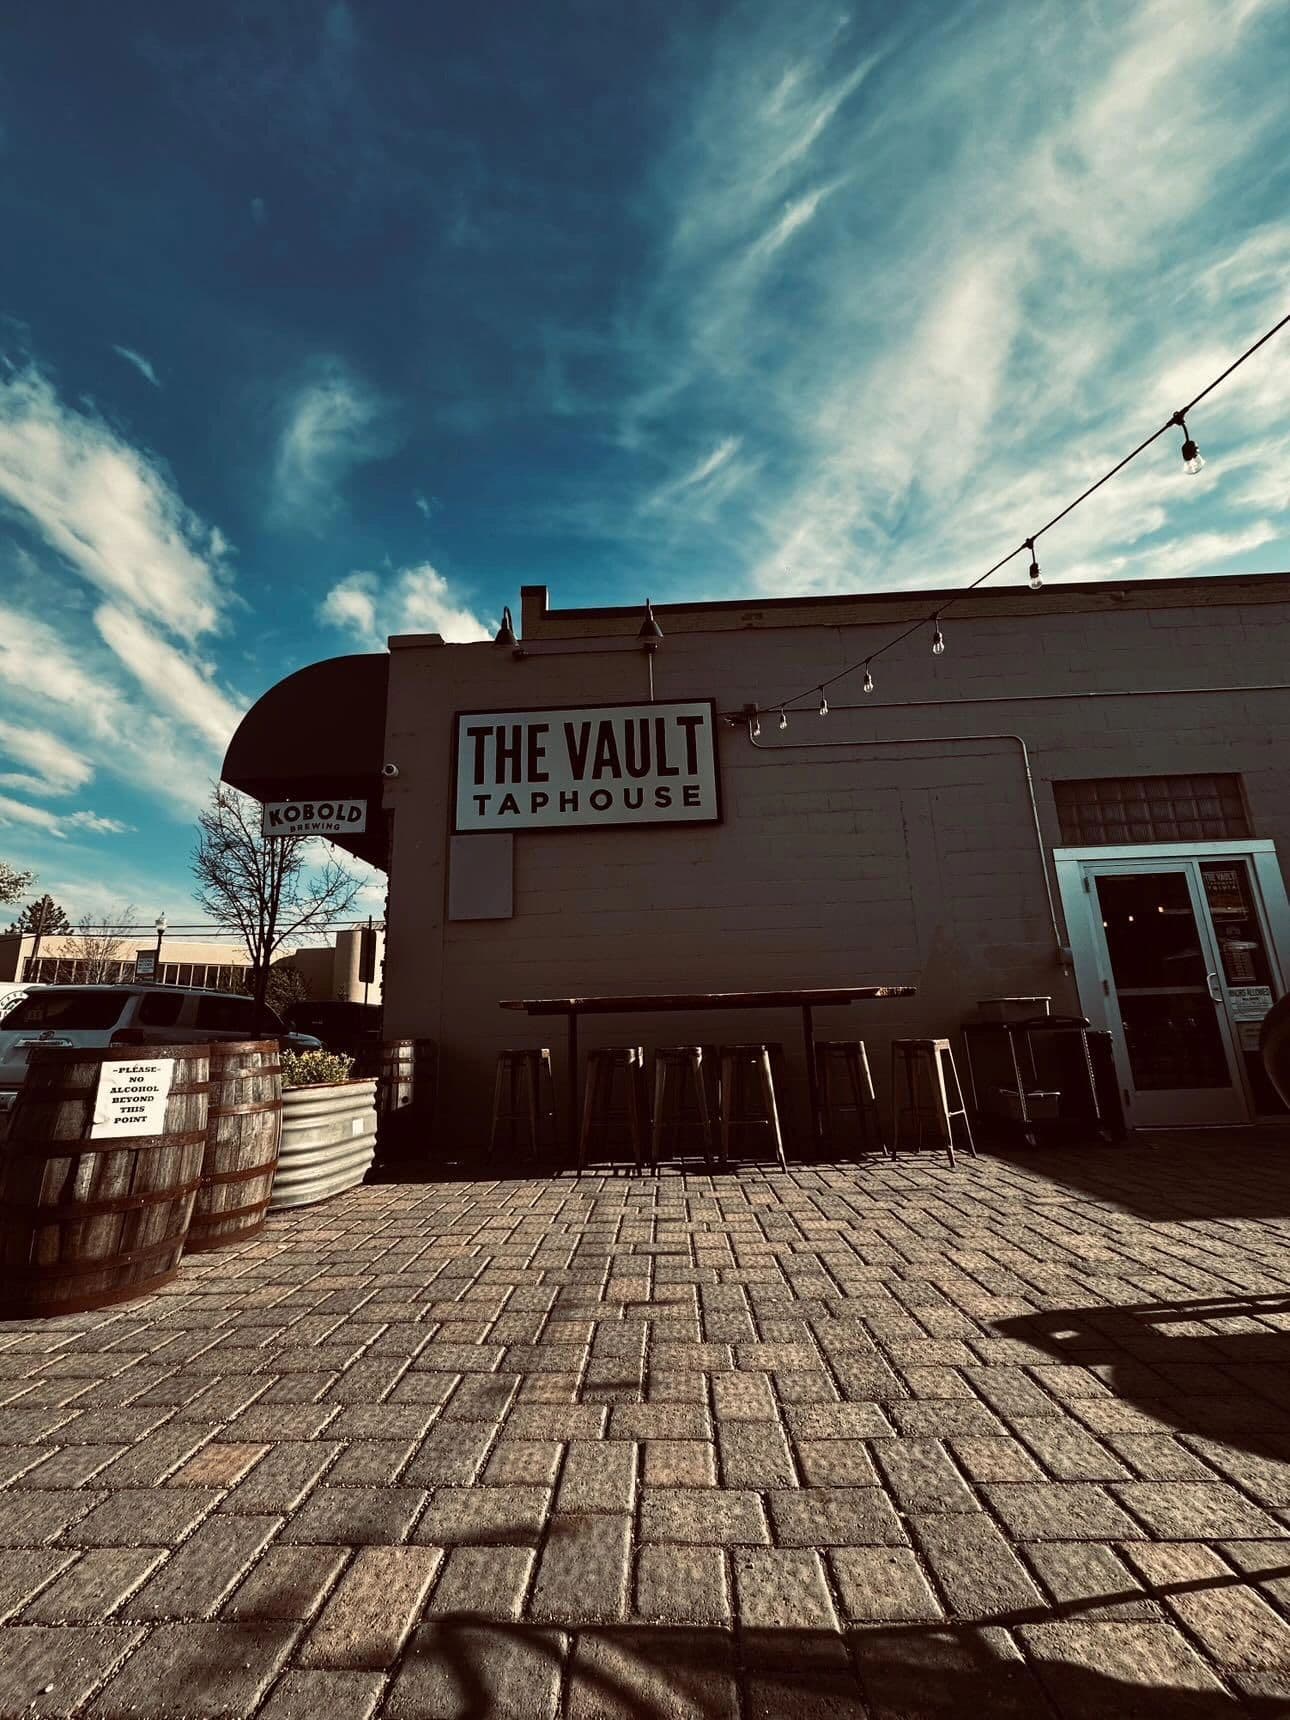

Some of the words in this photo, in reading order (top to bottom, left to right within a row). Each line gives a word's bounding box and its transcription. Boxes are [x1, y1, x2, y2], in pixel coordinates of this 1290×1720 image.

[467, 723, 549, 785] THE
[563, 715, 704, 781] VAULT
[473, 785, 702, 816] TAPHOUSE
[269, 803, 362, 827] KOBOLD
[290, 822, 341, 832] BREWING
[110, 1086, 159, 1094] ALCOHOL
[114, 1116, 147, 1124] POINT
